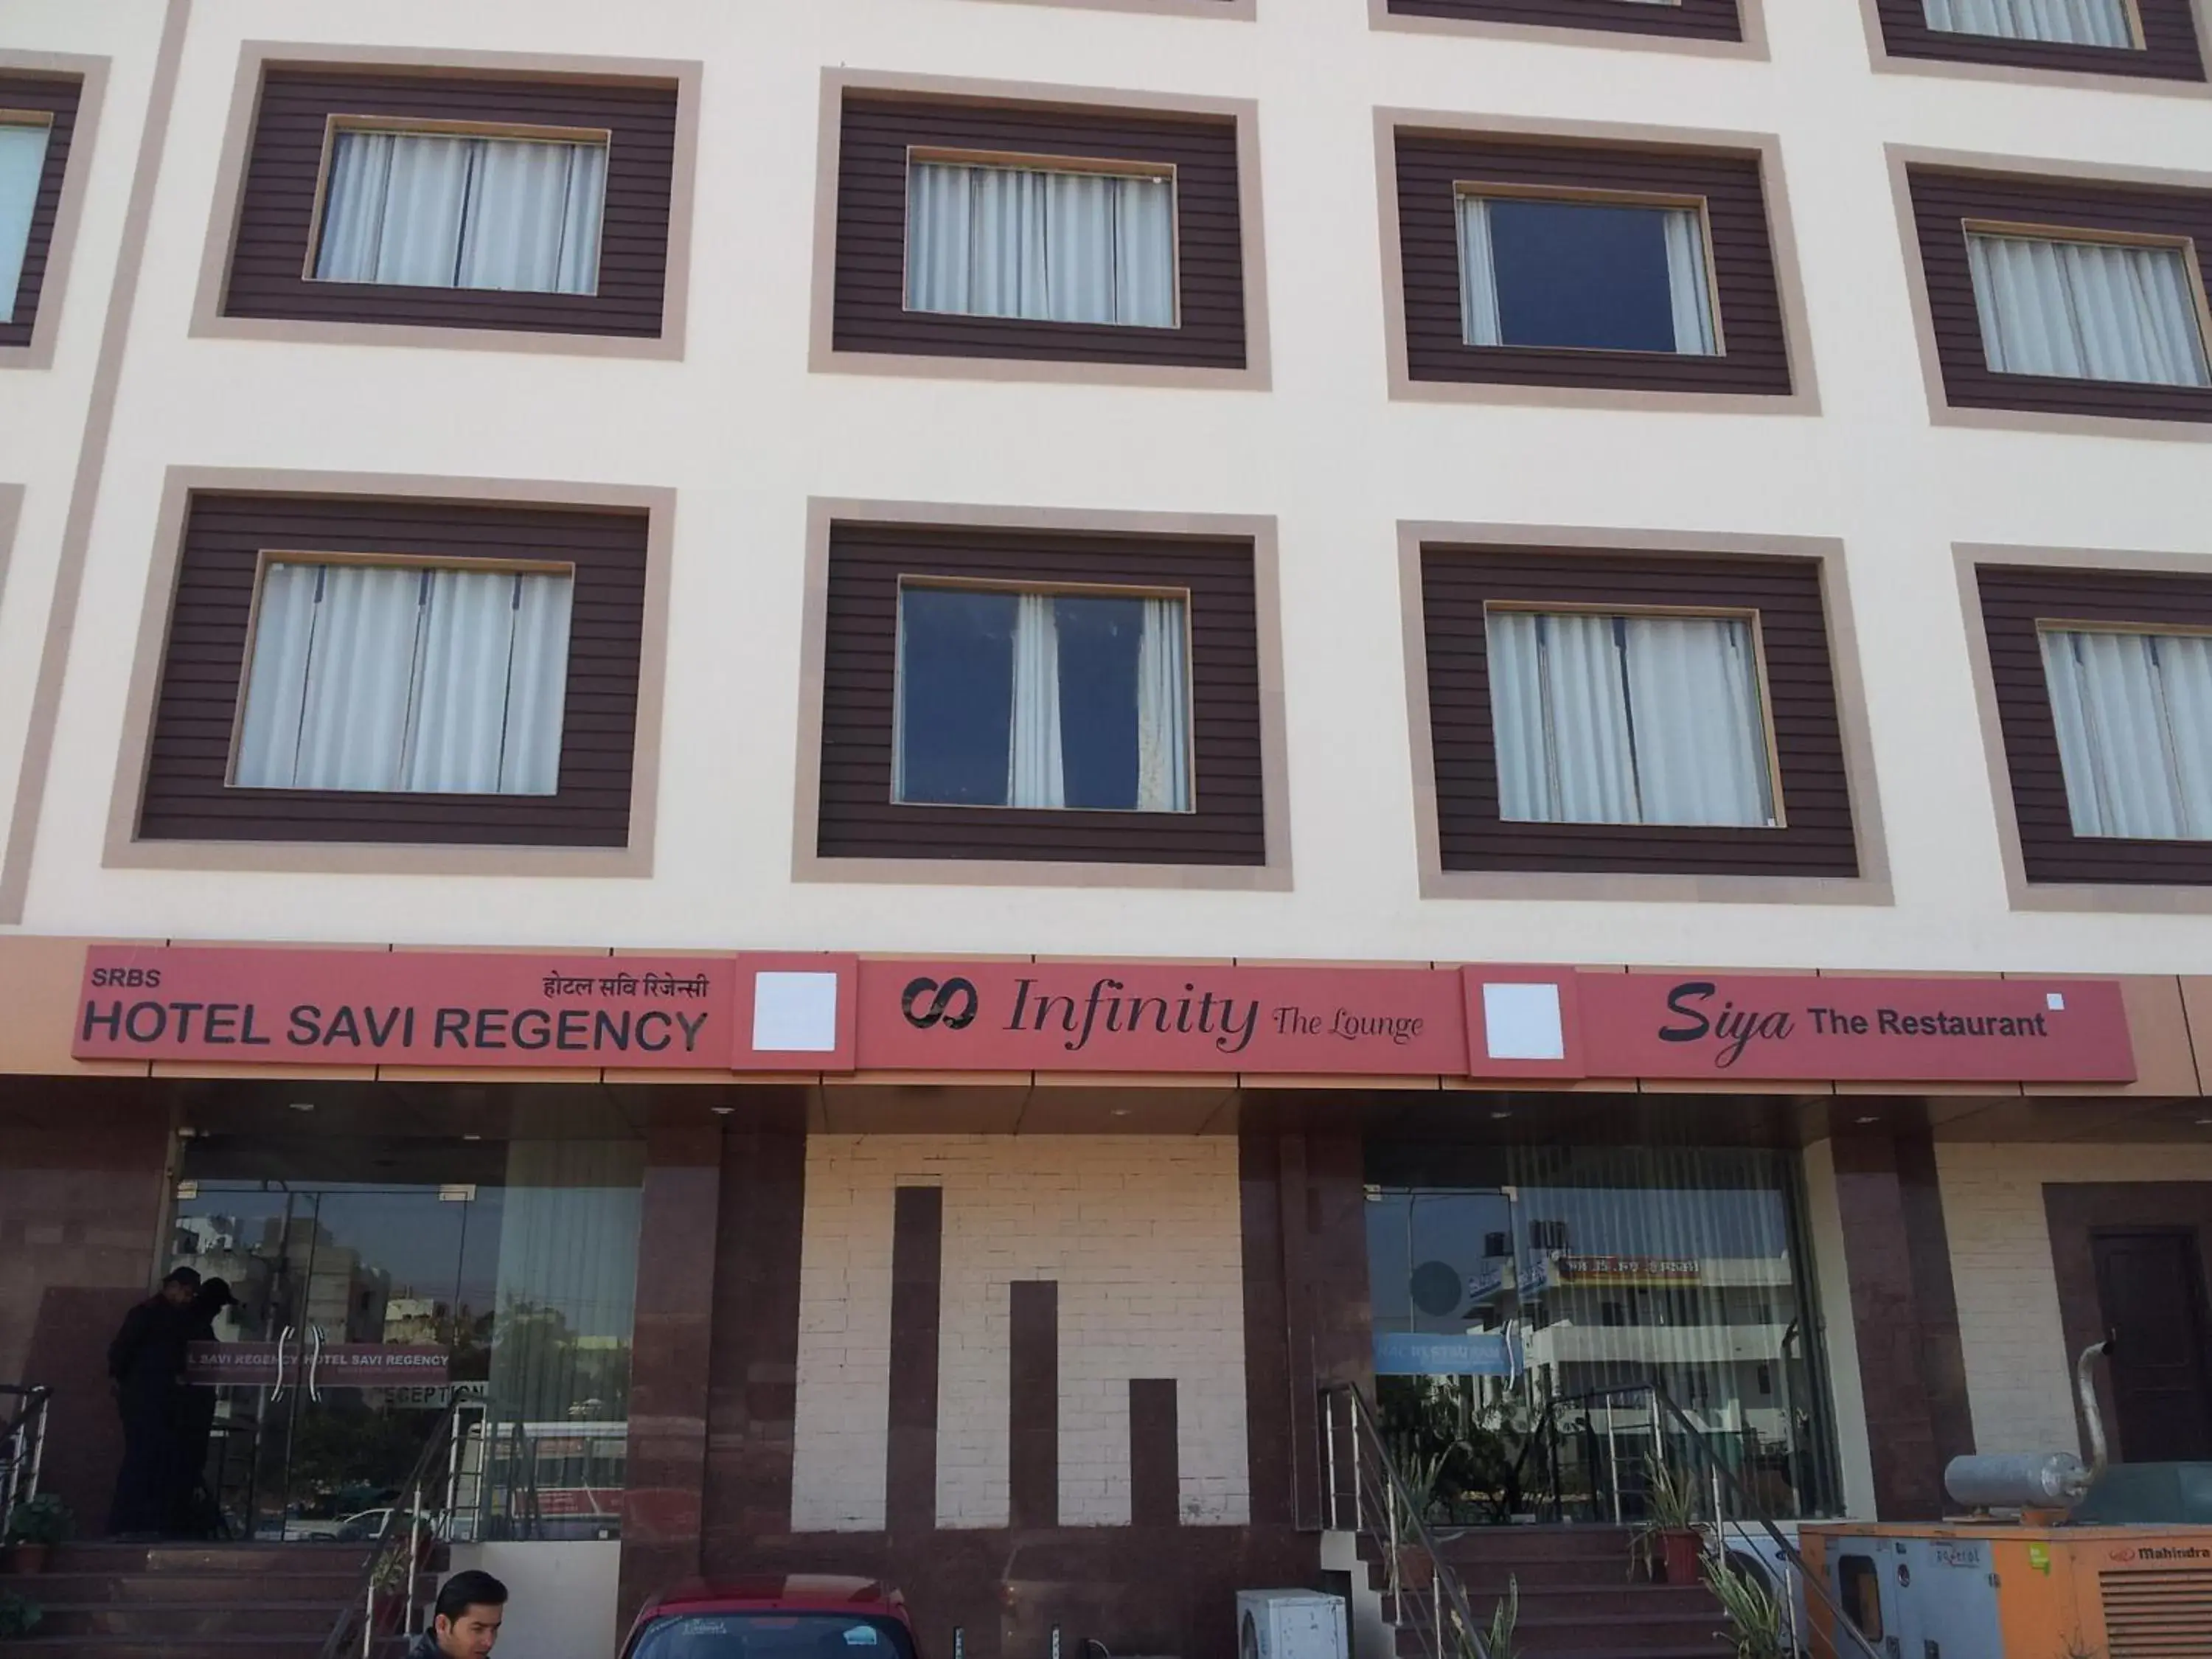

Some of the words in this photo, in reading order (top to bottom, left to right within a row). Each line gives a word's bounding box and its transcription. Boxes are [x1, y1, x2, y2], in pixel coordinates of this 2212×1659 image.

[91, 967, 162, 990] SRBS
[543, 970, 594, 999] होटल
[599, 973, 639, 998] सवि
[82, 1000, 272, 1047] HOTEL
[287, 1004, 416, 1049] SAVI
[434, 1008, 710, 1054] REGENCY
[1003, 978, 1260, 1054] Infinity
[1271, 1006, 1323, 1036] The
[1328, 1008, 1425, 1046] Lounge
[1658, 981, 1797, 1070] Siya
[1806, 1007, 1869, 1037] The
[1874, 1007, 2048, 1038] Restaurant
[352, 1354, 382, 1366] SAVI
[386, 1354, 449, 1366] REGENCY
[373, 1385, 484, 1404] ECEPTION
[2138, 1547, 2211, 1560] Mahindra
